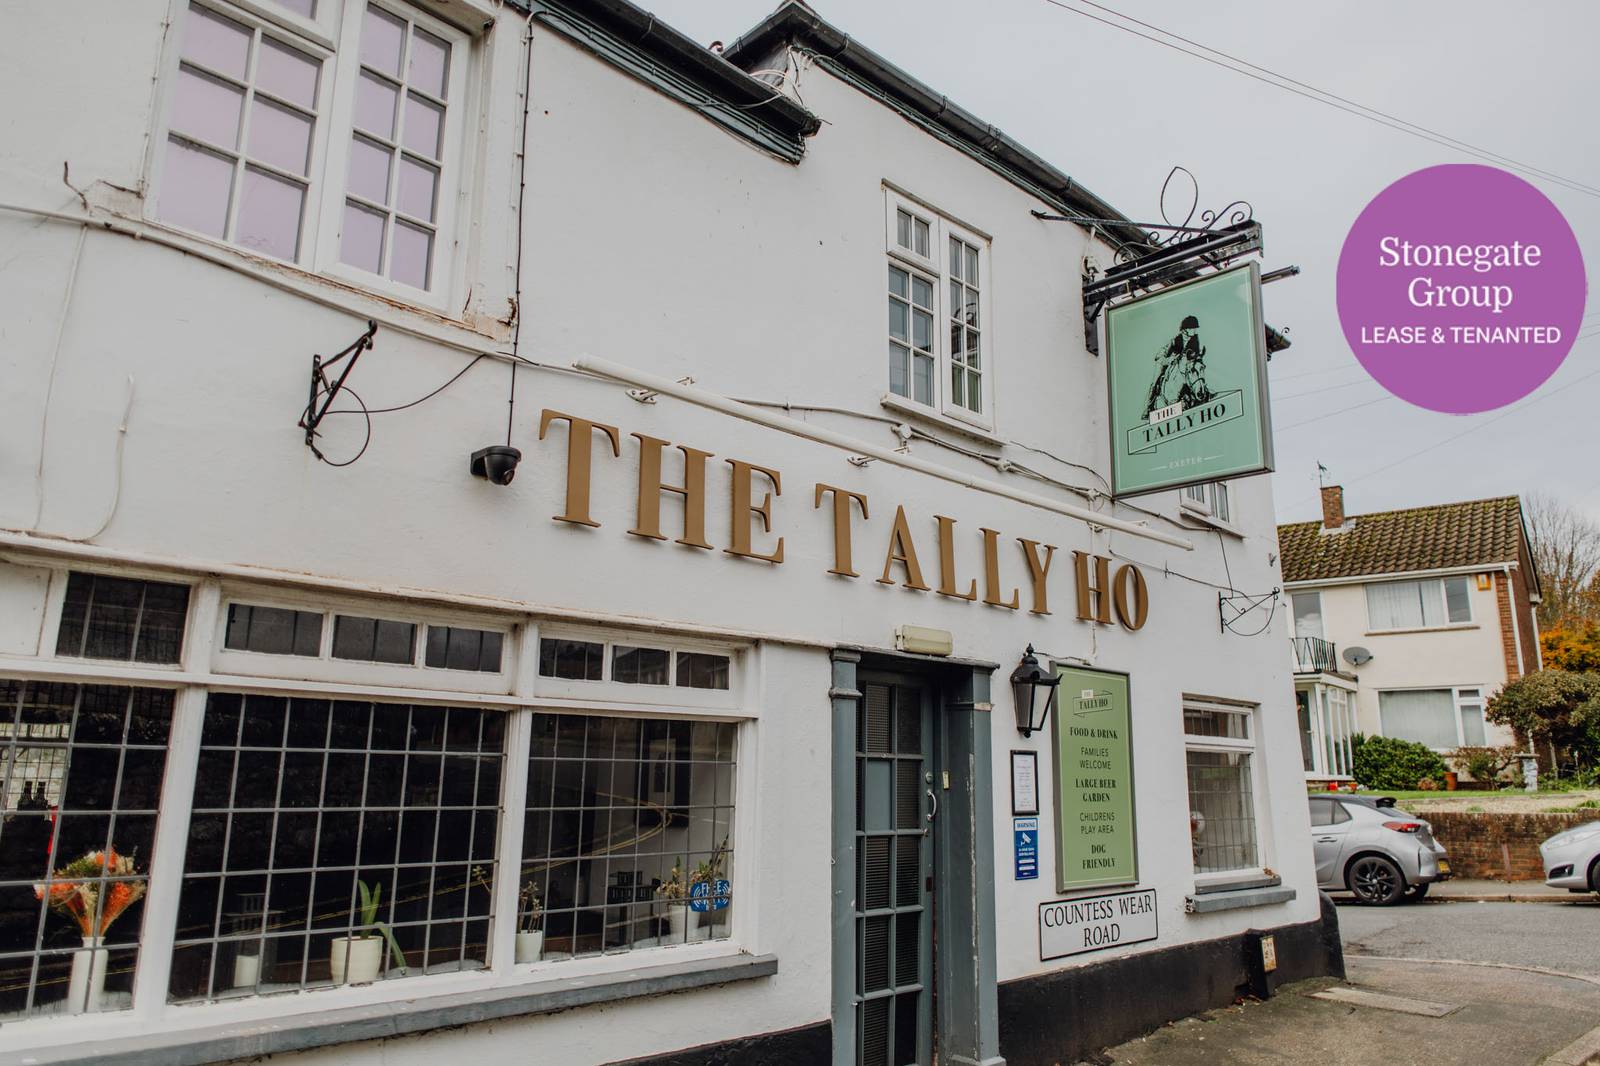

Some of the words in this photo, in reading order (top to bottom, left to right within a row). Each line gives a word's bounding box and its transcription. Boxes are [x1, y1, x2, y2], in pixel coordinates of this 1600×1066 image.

[1156, 407, 1175, 420] THE
[1142, 412, 1196, 442] TALLY
[1200, 403, 1226, 424] HO
[1168, 457, 1203, 469] EXETER
[539, 408, 785, 564] THE
[815, 482, 1058, 616] TALLY
[1072, 550, 1149, 632] HO
[1070, 726, 1089, 737] FOOD
[1090, 728, 1096, 738] &
[1097, 728, 1118, 740] DRINK
[1080, 746, 1109, 757] FAMILIES
[1080, 759, 1112, 770] WELCOME
[1075, 778, 1097, 788] LARGE
[1099, 778, 1117, 788] BEER
[1082, 792, 1110, 802] GARDEN
[1080, 811, 1115, 821] CHILDRENS
[1081, 825, 1096, 834] PLAY
[1098, 824, 1114, 834] AREA
[1091, 844, 1106, 854] DOG
[1082, 858, 1116, 869] FRIENDLY
[1044, 900, 1113, 927] COUNTESS
[1118, 895, 1152, 916] WEAR
[1084, 923, 1121, 947] ROAD
